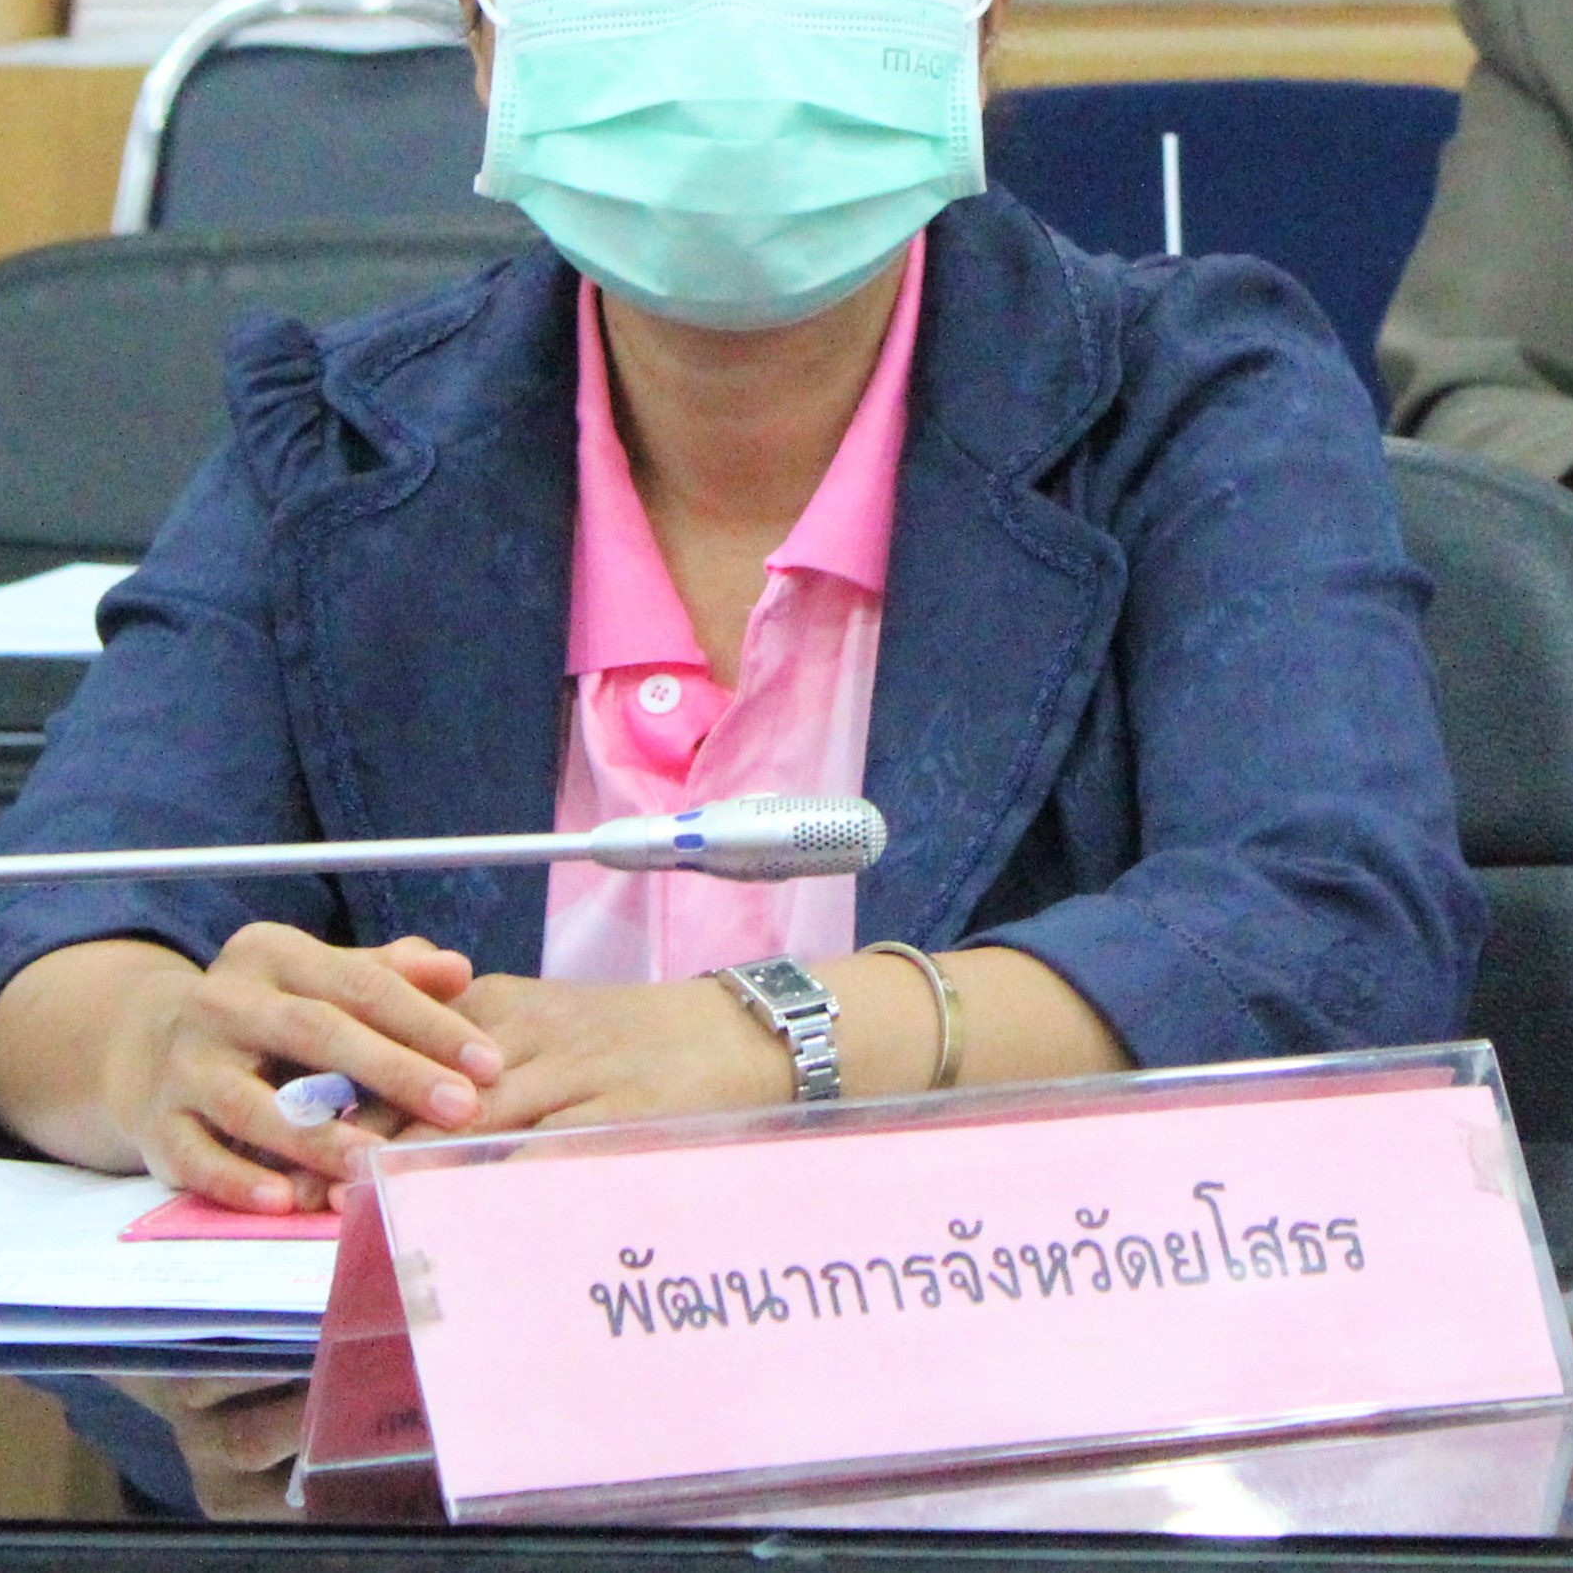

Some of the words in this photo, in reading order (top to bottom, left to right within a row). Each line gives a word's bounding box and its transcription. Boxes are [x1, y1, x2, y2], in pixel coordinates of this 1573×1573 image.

[589, 1182, 1366, 1339] พัฒนาการจังหวัดยโสธร
